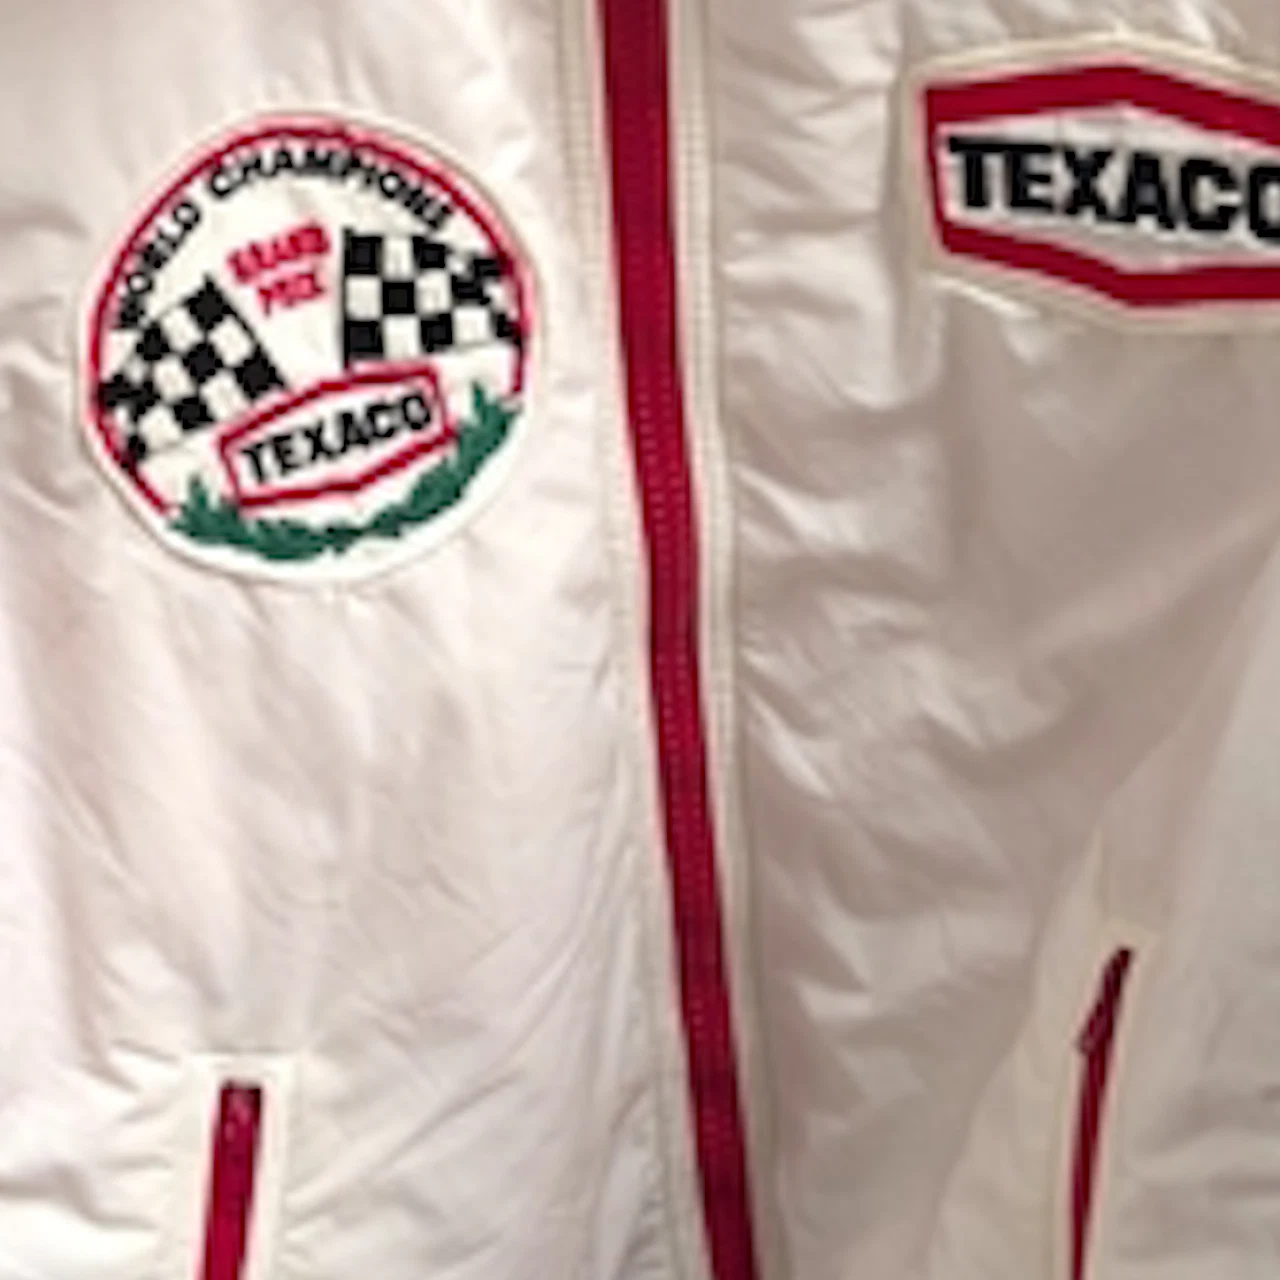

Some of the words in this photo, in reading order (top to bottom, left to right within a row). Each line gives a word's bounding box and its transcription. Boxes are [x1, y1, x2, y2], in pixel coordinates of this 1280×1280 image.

[111, 201, 201, 329] WORLD
[207, 147, 454, 231] CHAMPIONS
[242, 393, 433, 484] TEXACO
